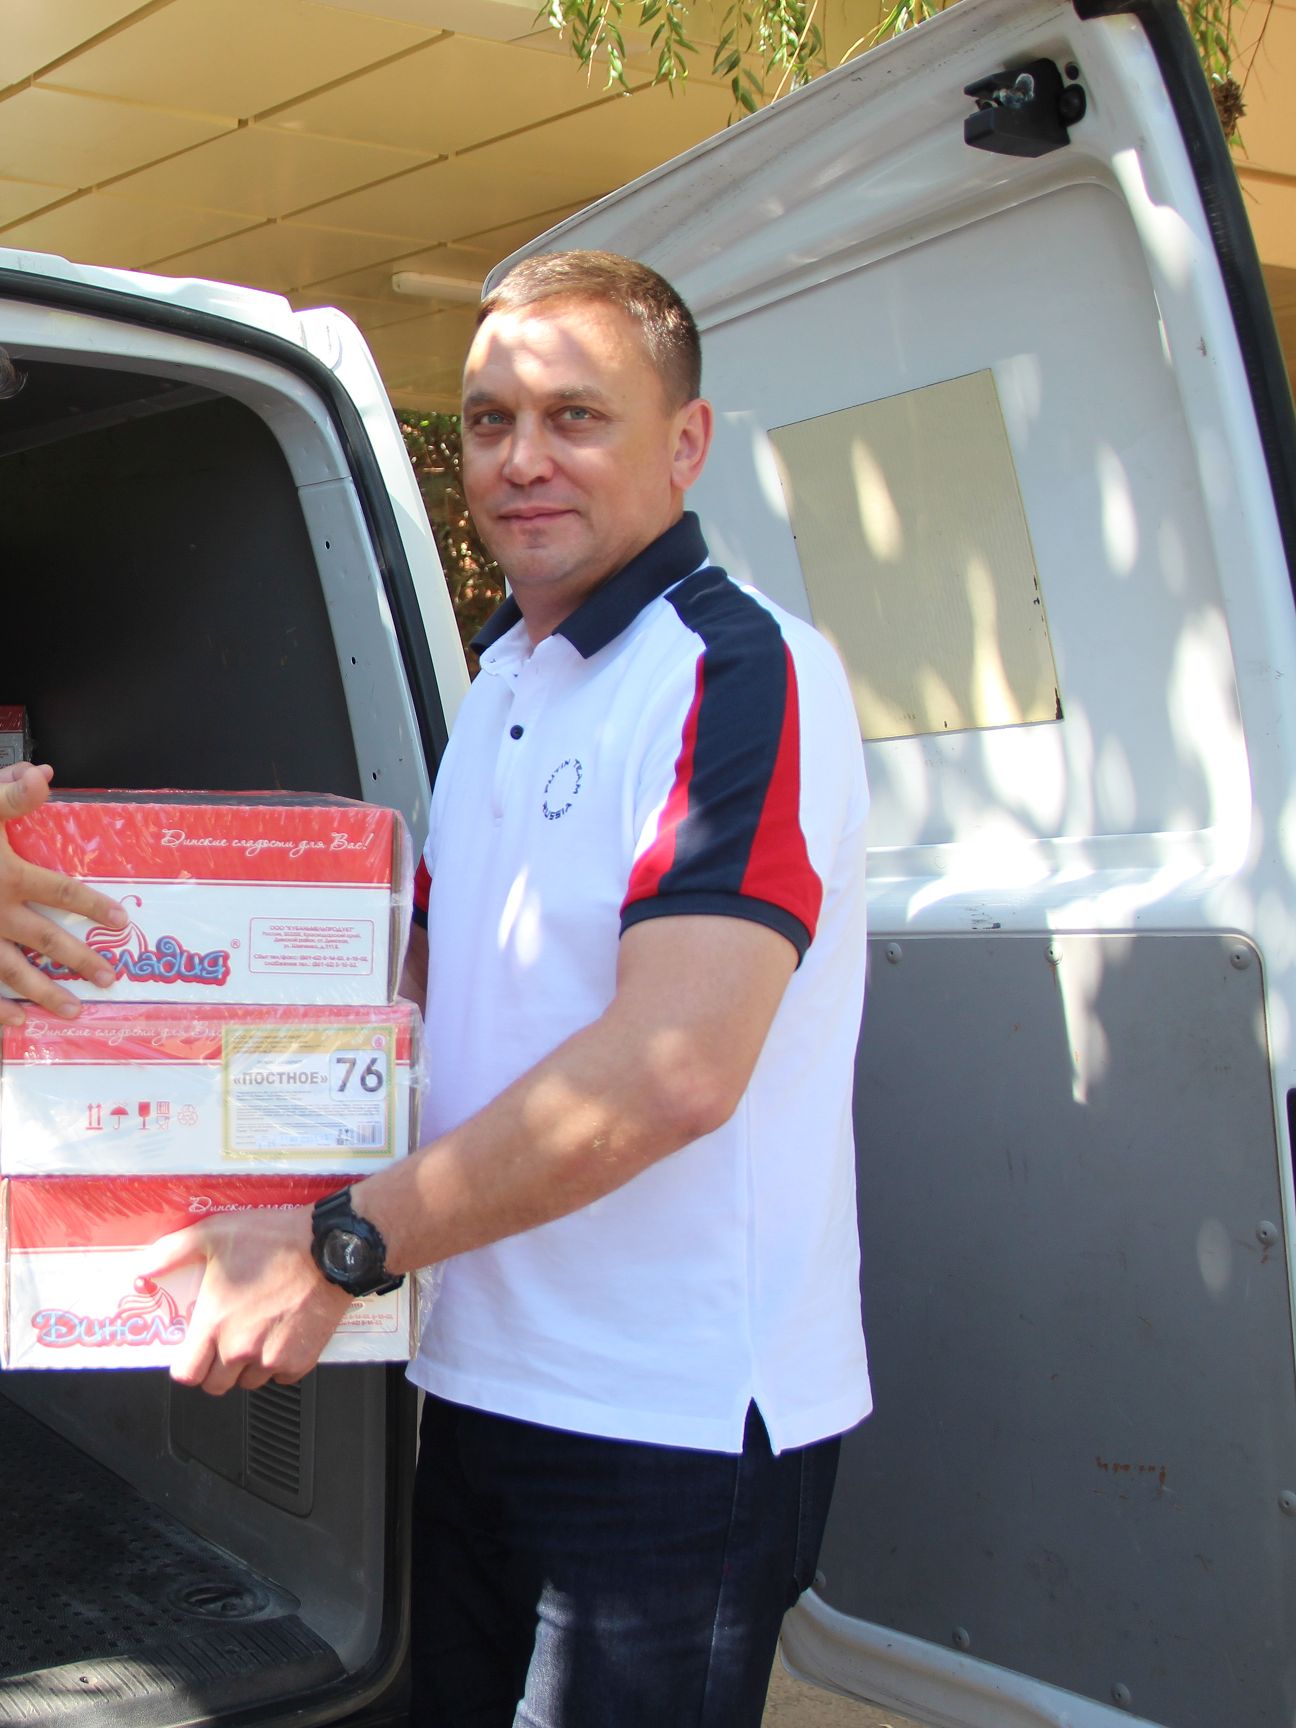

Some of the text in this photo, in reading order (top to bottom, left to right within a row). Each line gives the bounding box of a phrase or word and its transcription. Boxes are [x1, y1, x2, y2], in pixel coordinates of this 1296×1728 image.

[542, 800, 573, 820] RUSSIA
[160, 828, 375, 858] Динские сладости для Вас!
[24, 1019, 91, 1039] Динские
[234, 1071, 328, 1086] «ПОСТНОЕ»
[336, 1057, 384, 1093] 76
[188, 1196, 252, 1213] Динские
[31, 1308, 187, 1348] Динсла
